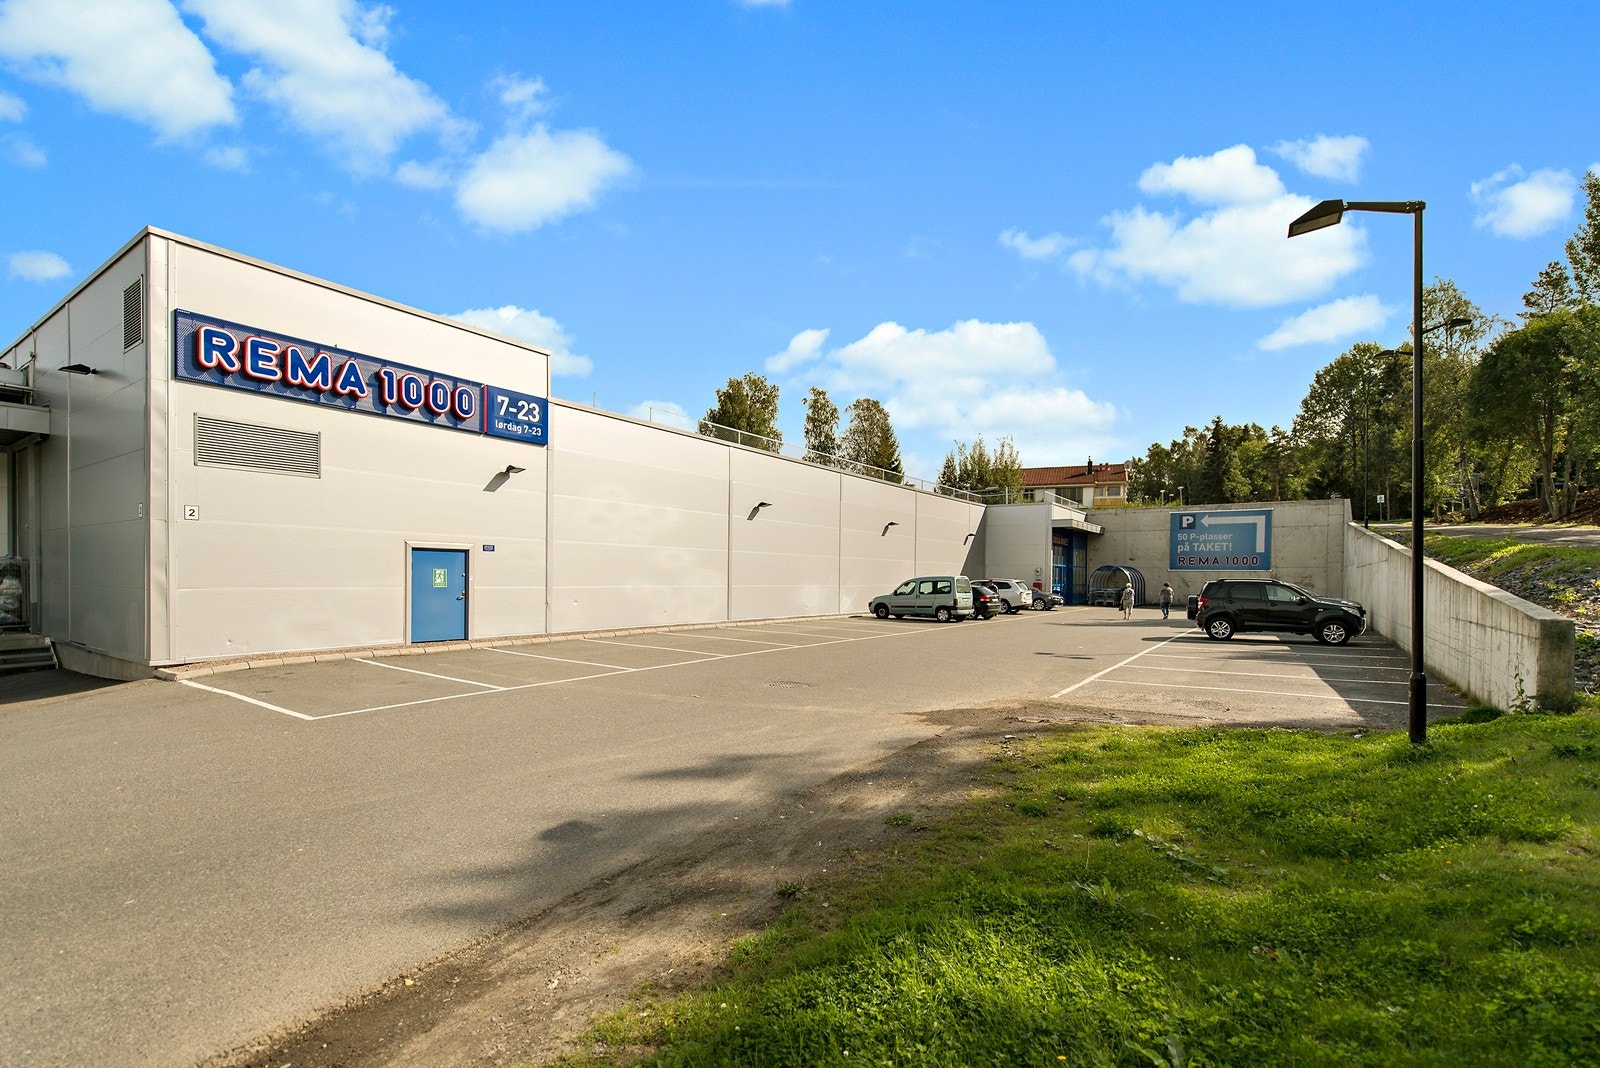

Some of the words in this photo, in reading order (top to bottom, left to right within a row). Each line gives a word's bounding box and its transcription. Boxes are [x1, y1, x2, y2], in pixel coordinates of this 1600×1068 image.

[197, 324, 368, 399] REMA
[378, 366, 476, 420] 1000
[497, 395, 540, 423] 7-23
[495, 420, 522, 434] lørdag
[523, 425, 542, 436] 7-23
[189, 508, 195, 517] 2
[1182, 515, 1195, 528] P
[1177, 533, 1188, 541] 50
[1190, 532, 1233, 543] P-plasser
[1177, 542, 1190, 553] på
[1193, 542, 1233, 552] TAKET!
[1177, 555, 1220, 567] REMA
[1225, 555, 1260, 567] 1000
